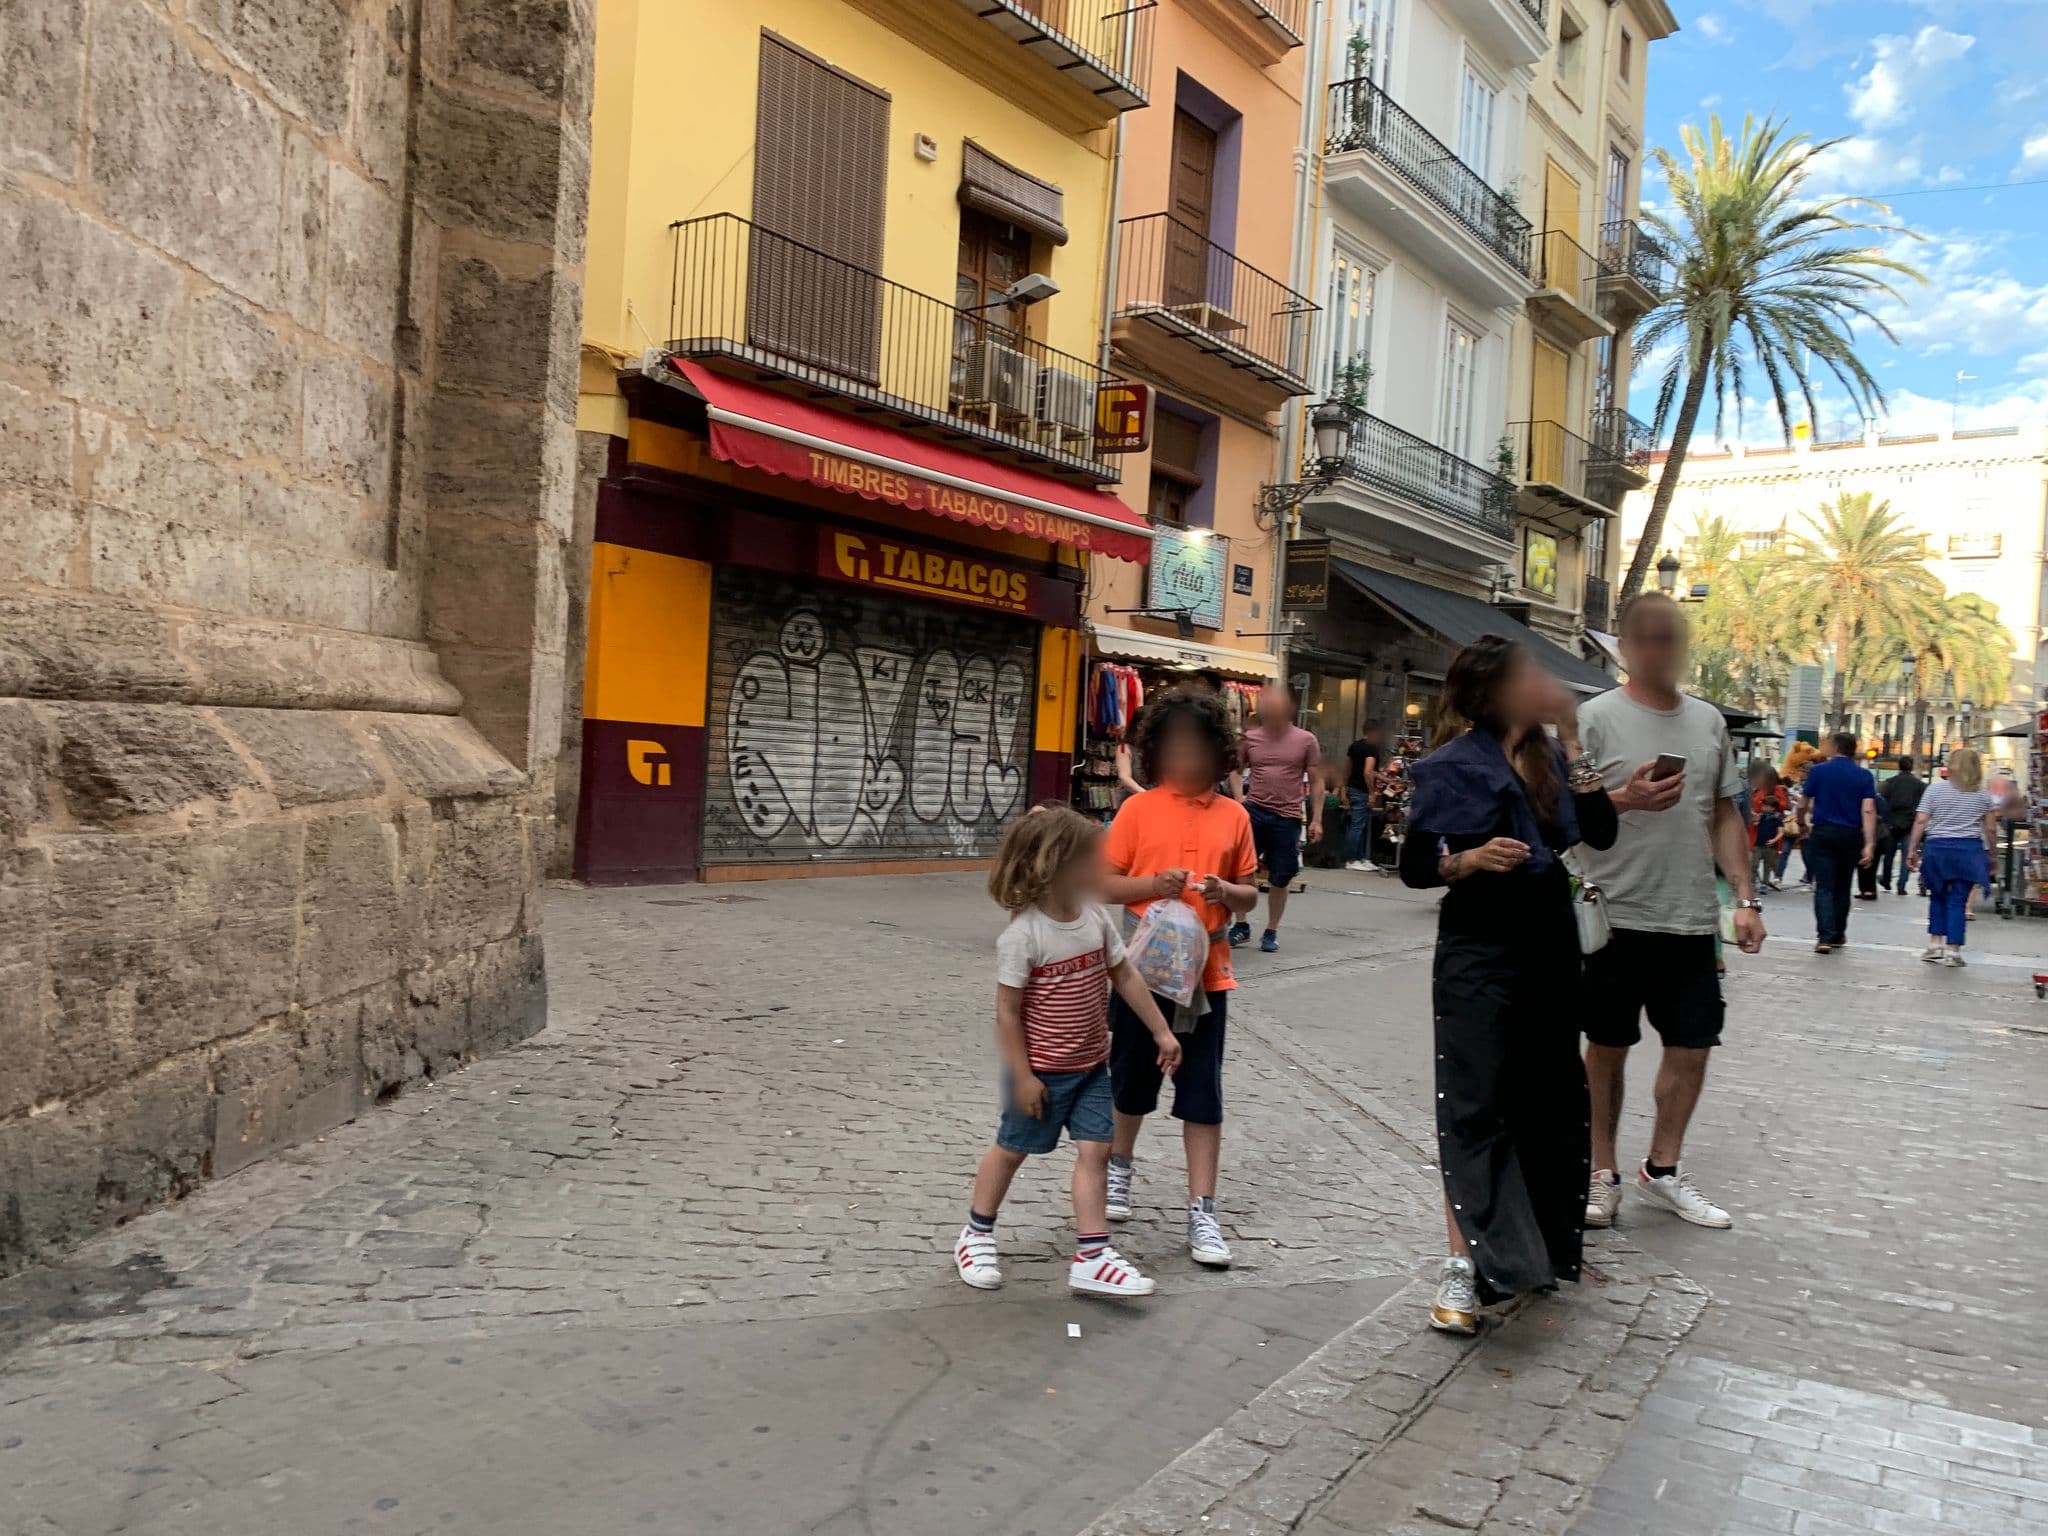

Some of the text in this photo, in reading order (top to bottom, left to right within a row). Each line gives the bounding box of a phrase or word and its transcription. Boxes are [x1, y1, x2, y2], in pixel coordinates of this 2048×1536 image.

[808, 452, 909, 501] TIMBRES
[926, 484, 1008, 525] TABACO
[1023, 510, 1091, 546] STAMPS
[880, 543, 1027, 601] TABACOS
